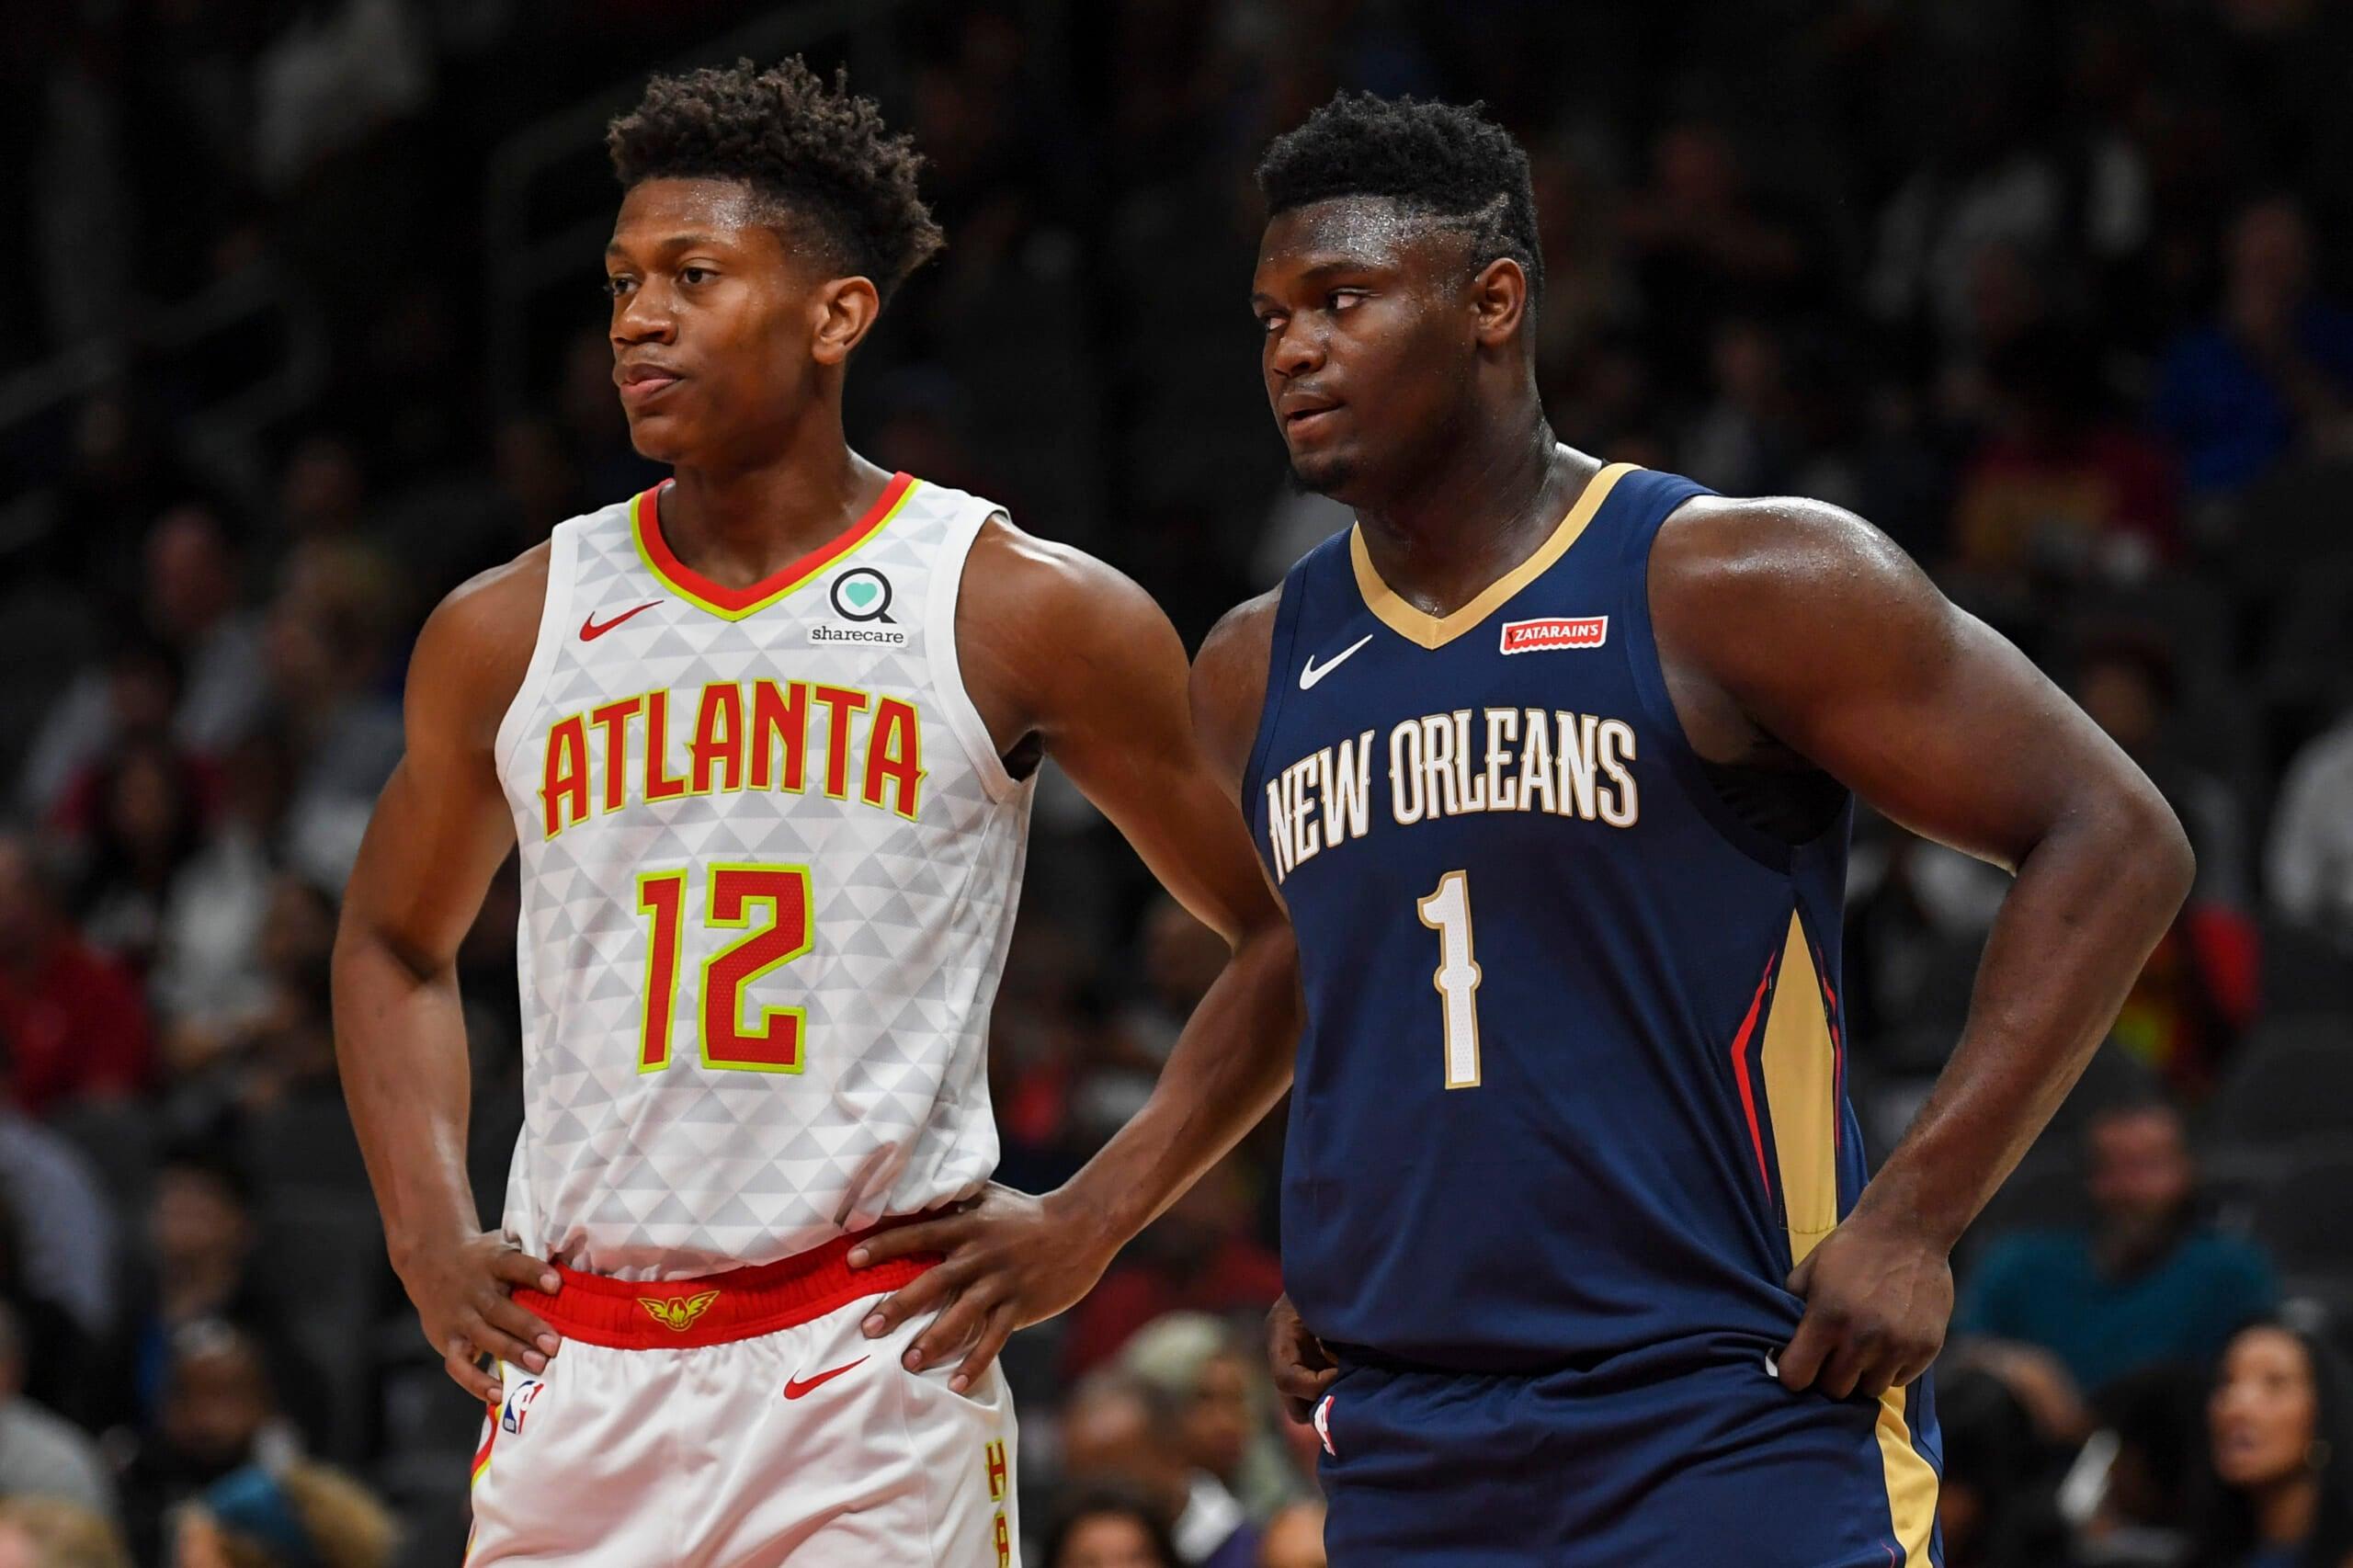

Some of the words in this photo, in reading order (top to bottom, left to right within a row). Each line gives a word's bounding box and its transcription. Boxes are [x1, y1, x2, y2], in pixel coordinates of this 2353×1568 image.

[812, 625, 904, 643] sharecare
[1514, 624, 1599, 642] ZATARAIN'S
[538, 678, 928, 841] ATLANTA
[1266, 729, 1375, 885] NEW
[1389, 708, 1639, 827] ORLEANS
[635, 861, 813, 1074] 12
[1416, 869, 1482, 1090] 1
